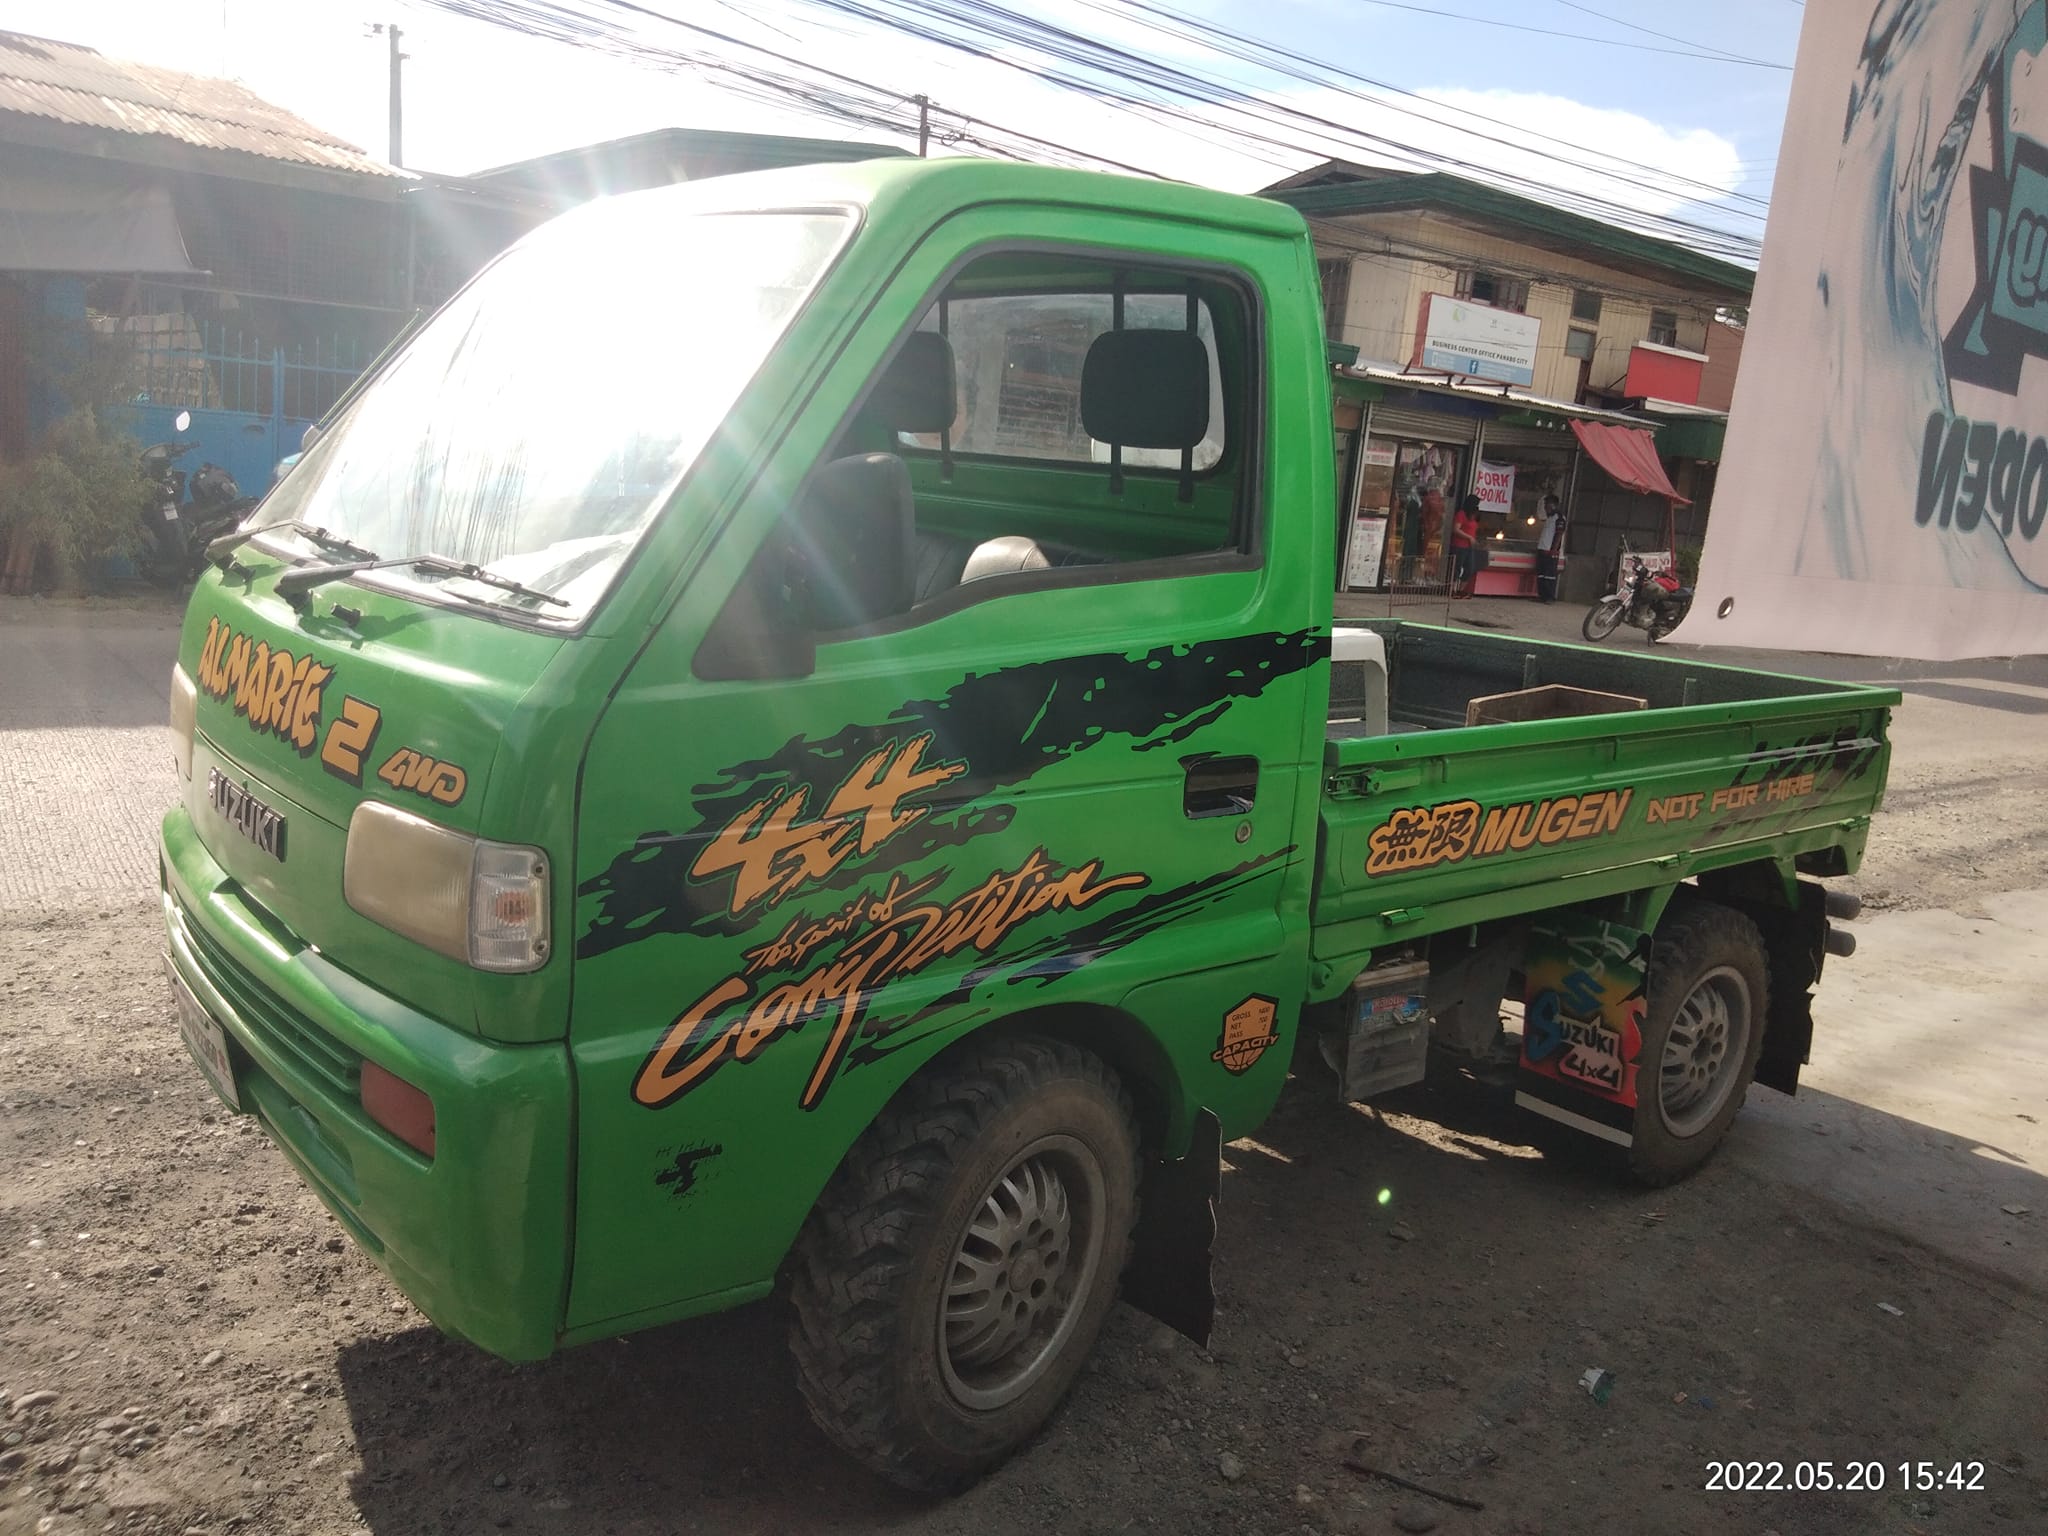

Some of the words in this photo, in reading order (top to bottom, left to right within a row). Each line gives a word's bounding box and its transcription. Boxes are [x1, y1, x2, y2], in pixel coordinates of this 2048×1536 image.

[1432, 340, 1457, 352] BUSINESS
[1458, 345, 1478, 355] CENTER
[1478, 349, 1496, 360] OFFICE
[321, 695, 382, 785] 2
[377, 746, 468, 807] 4WD
[1646, 791, 1704, 825] NOT
[1709, 785, 1759, 813] FOR
[1765, 773, 1816, 802] HIRE
[1473, 788, 1631, 856] MUGEN
[1231, 1010, 1252, 1022] GROSS
[1212, 1034, 1279, 1061] CAPACITY
